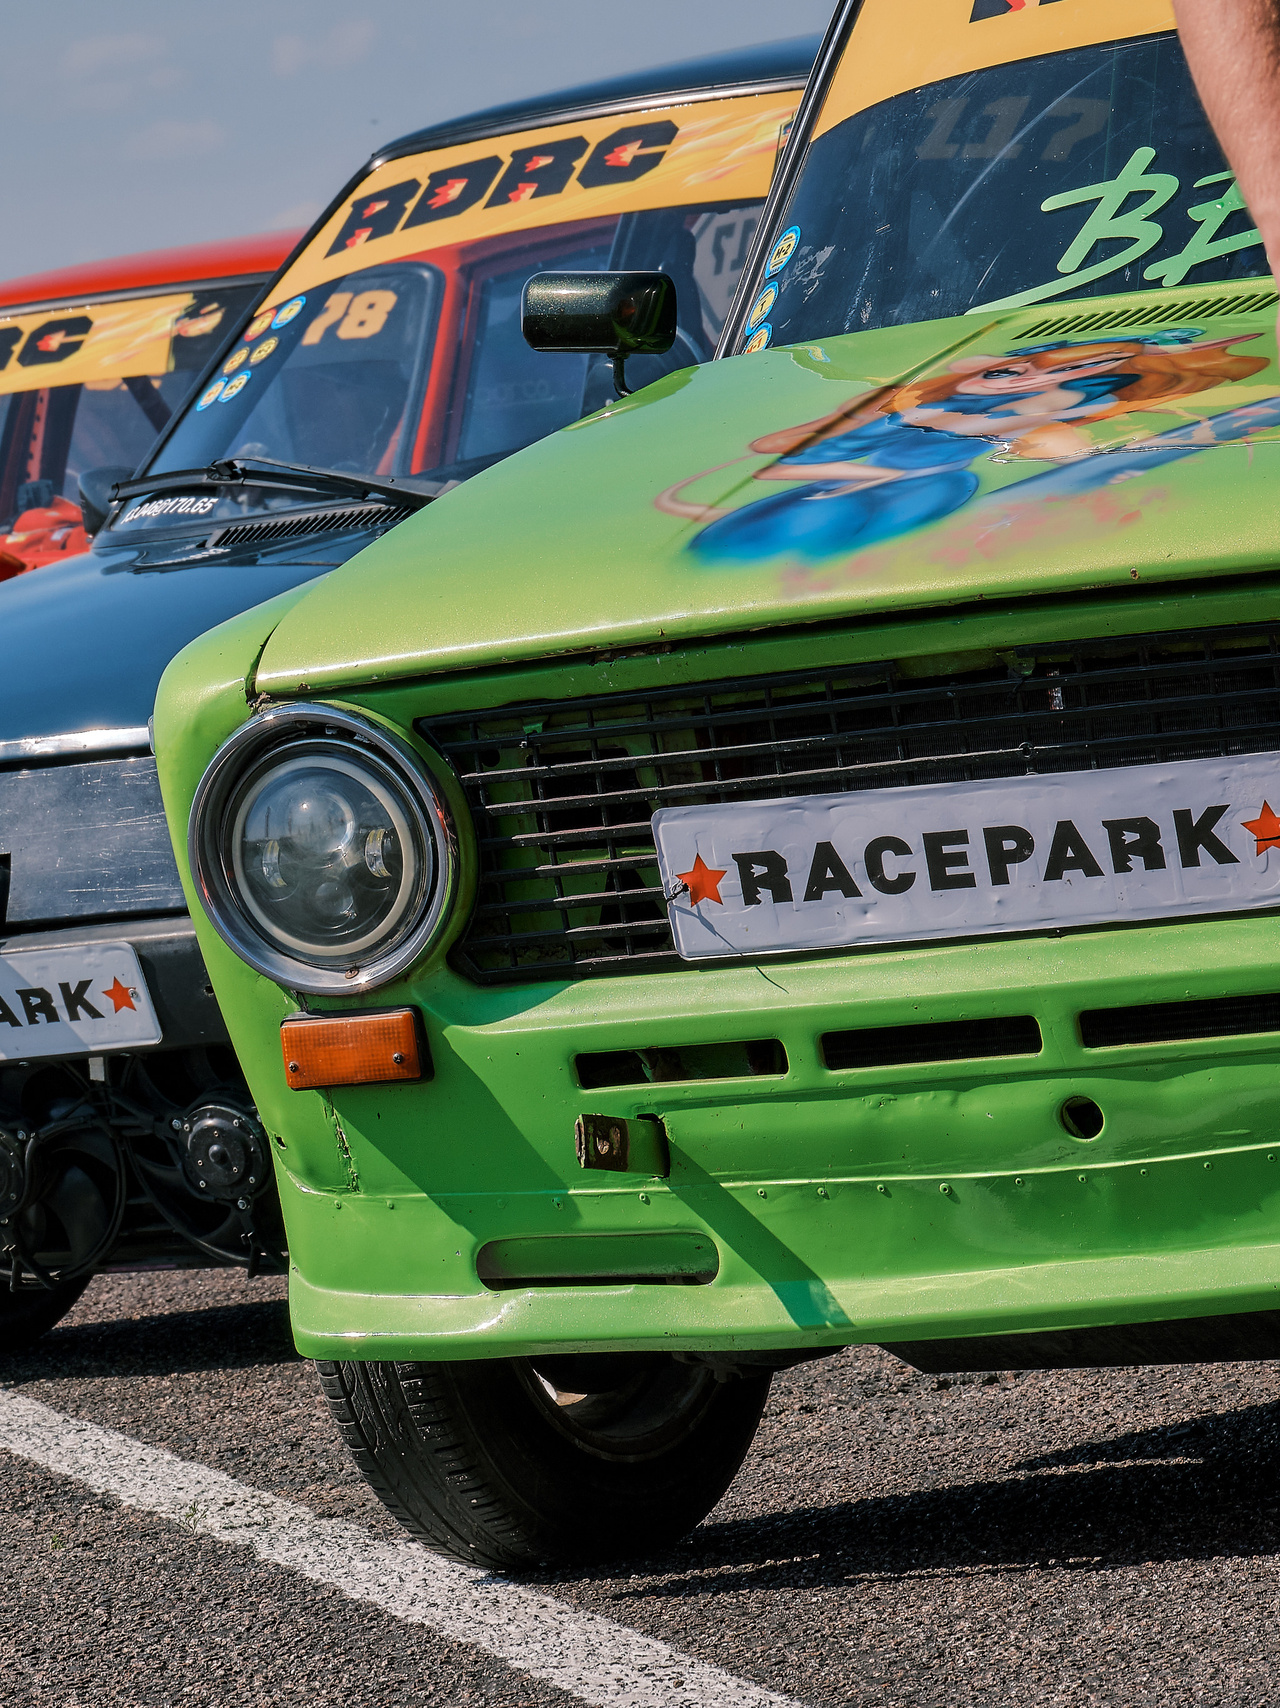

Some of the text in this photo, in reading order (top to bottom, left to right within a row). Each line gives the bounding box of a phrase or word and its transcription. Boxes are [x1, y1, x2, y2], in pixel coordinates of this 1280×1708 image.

[915, 96, 1111, 162] 117
[323, 120, 679, 259] RDRC
[301, 290, 398, 346] 78
[732, 803, 1240, 908] RACEPARK
